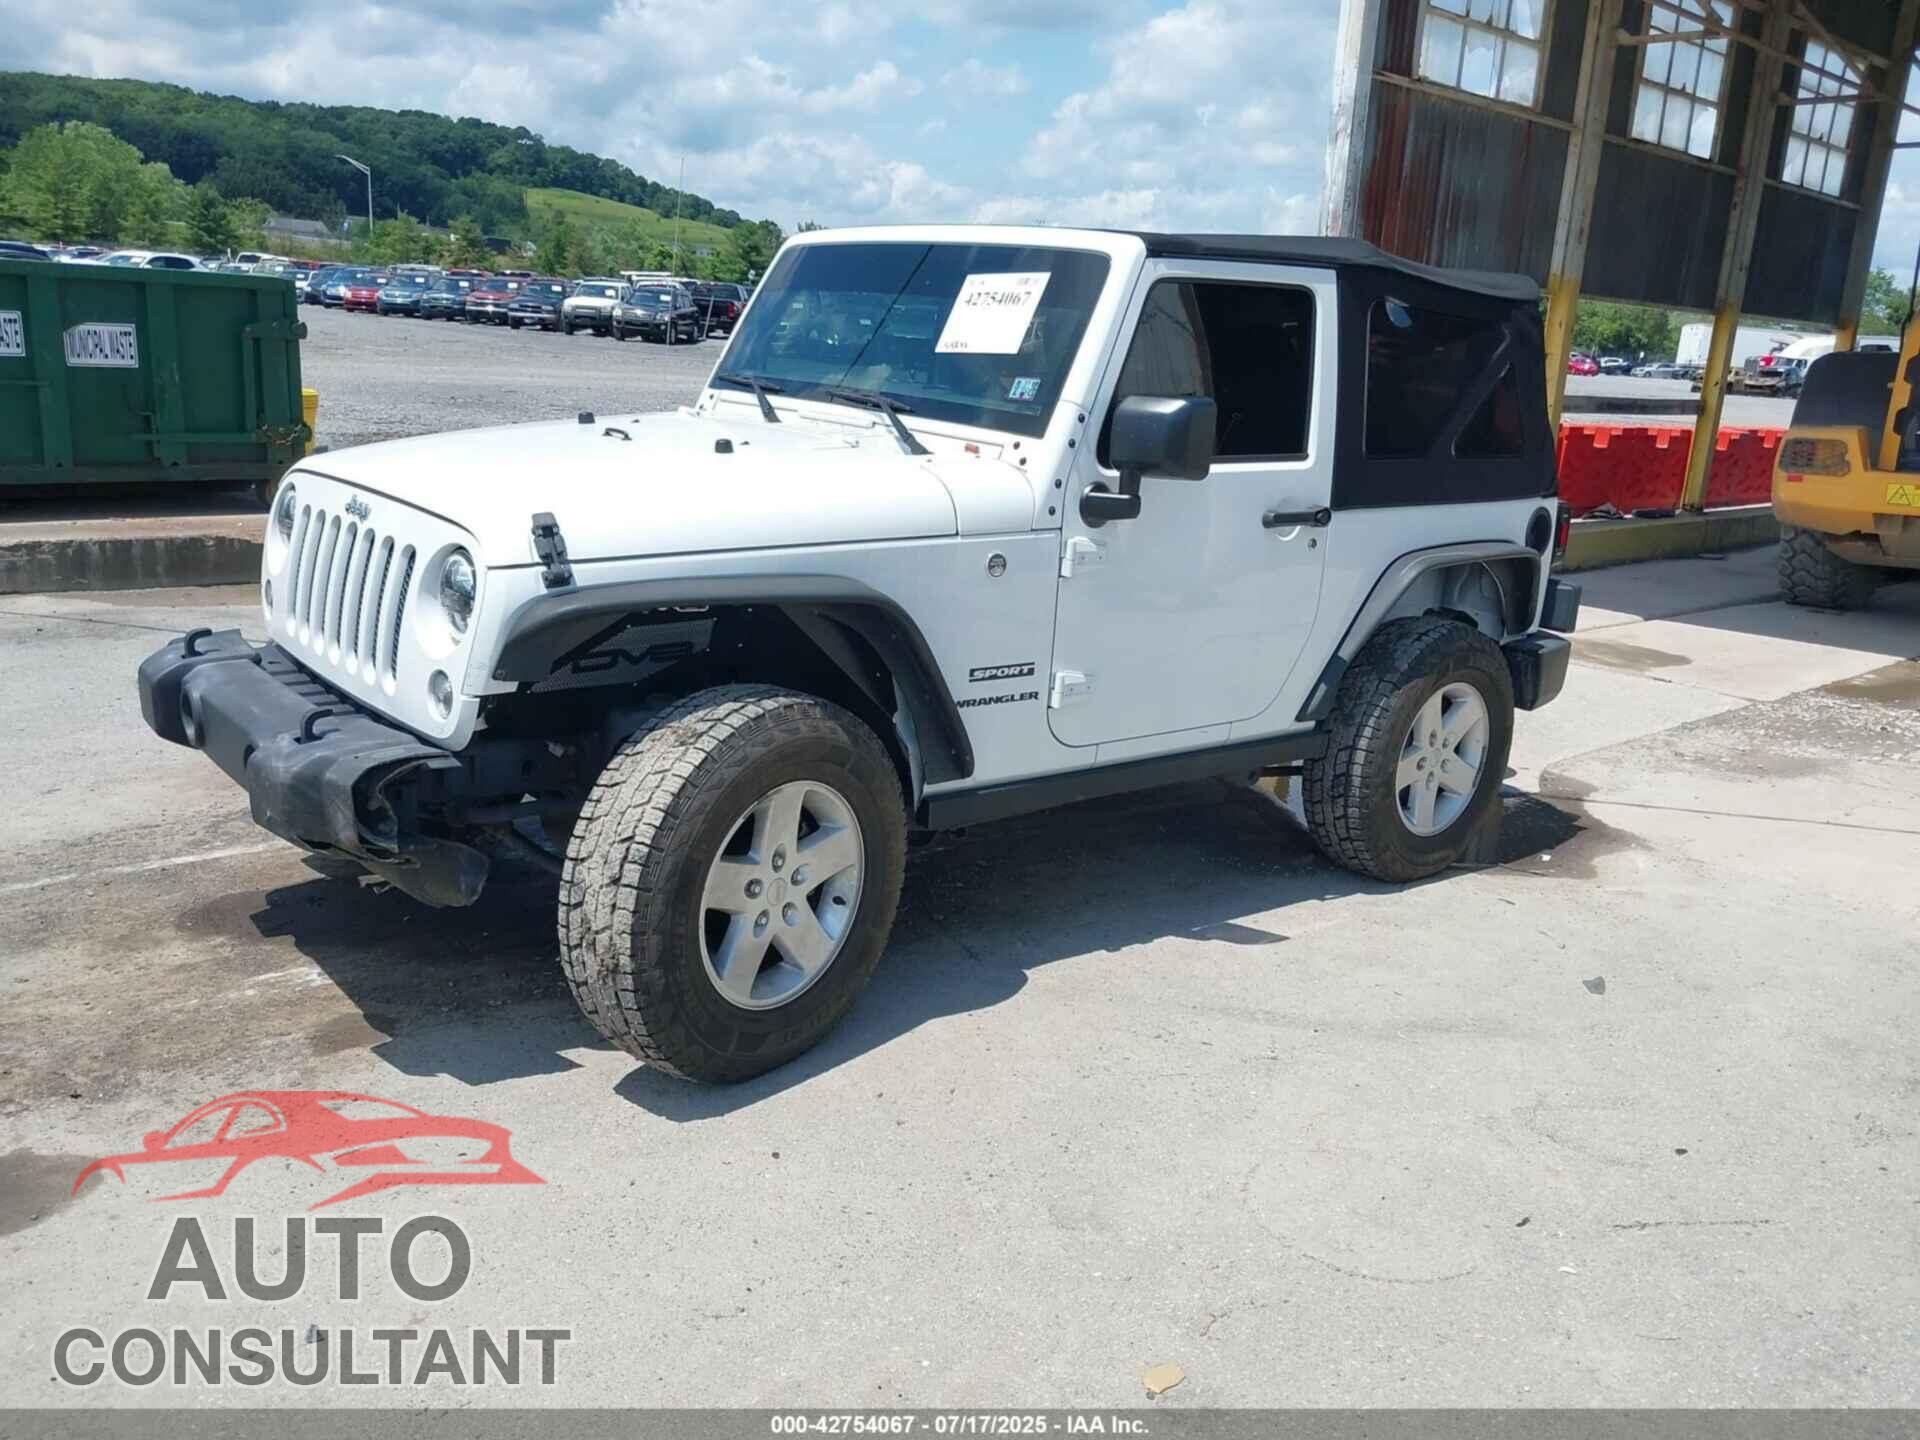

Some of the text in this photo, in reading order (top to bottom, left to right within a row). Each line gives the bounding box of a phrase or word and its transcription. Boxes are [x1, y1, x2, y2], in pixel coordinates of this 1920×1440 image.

[963, 290, 1033, 307] 42754067
[68, 328, 135, 361] MUNICIPAL WASTE
[973, 664, 1033, 679] SPORT
